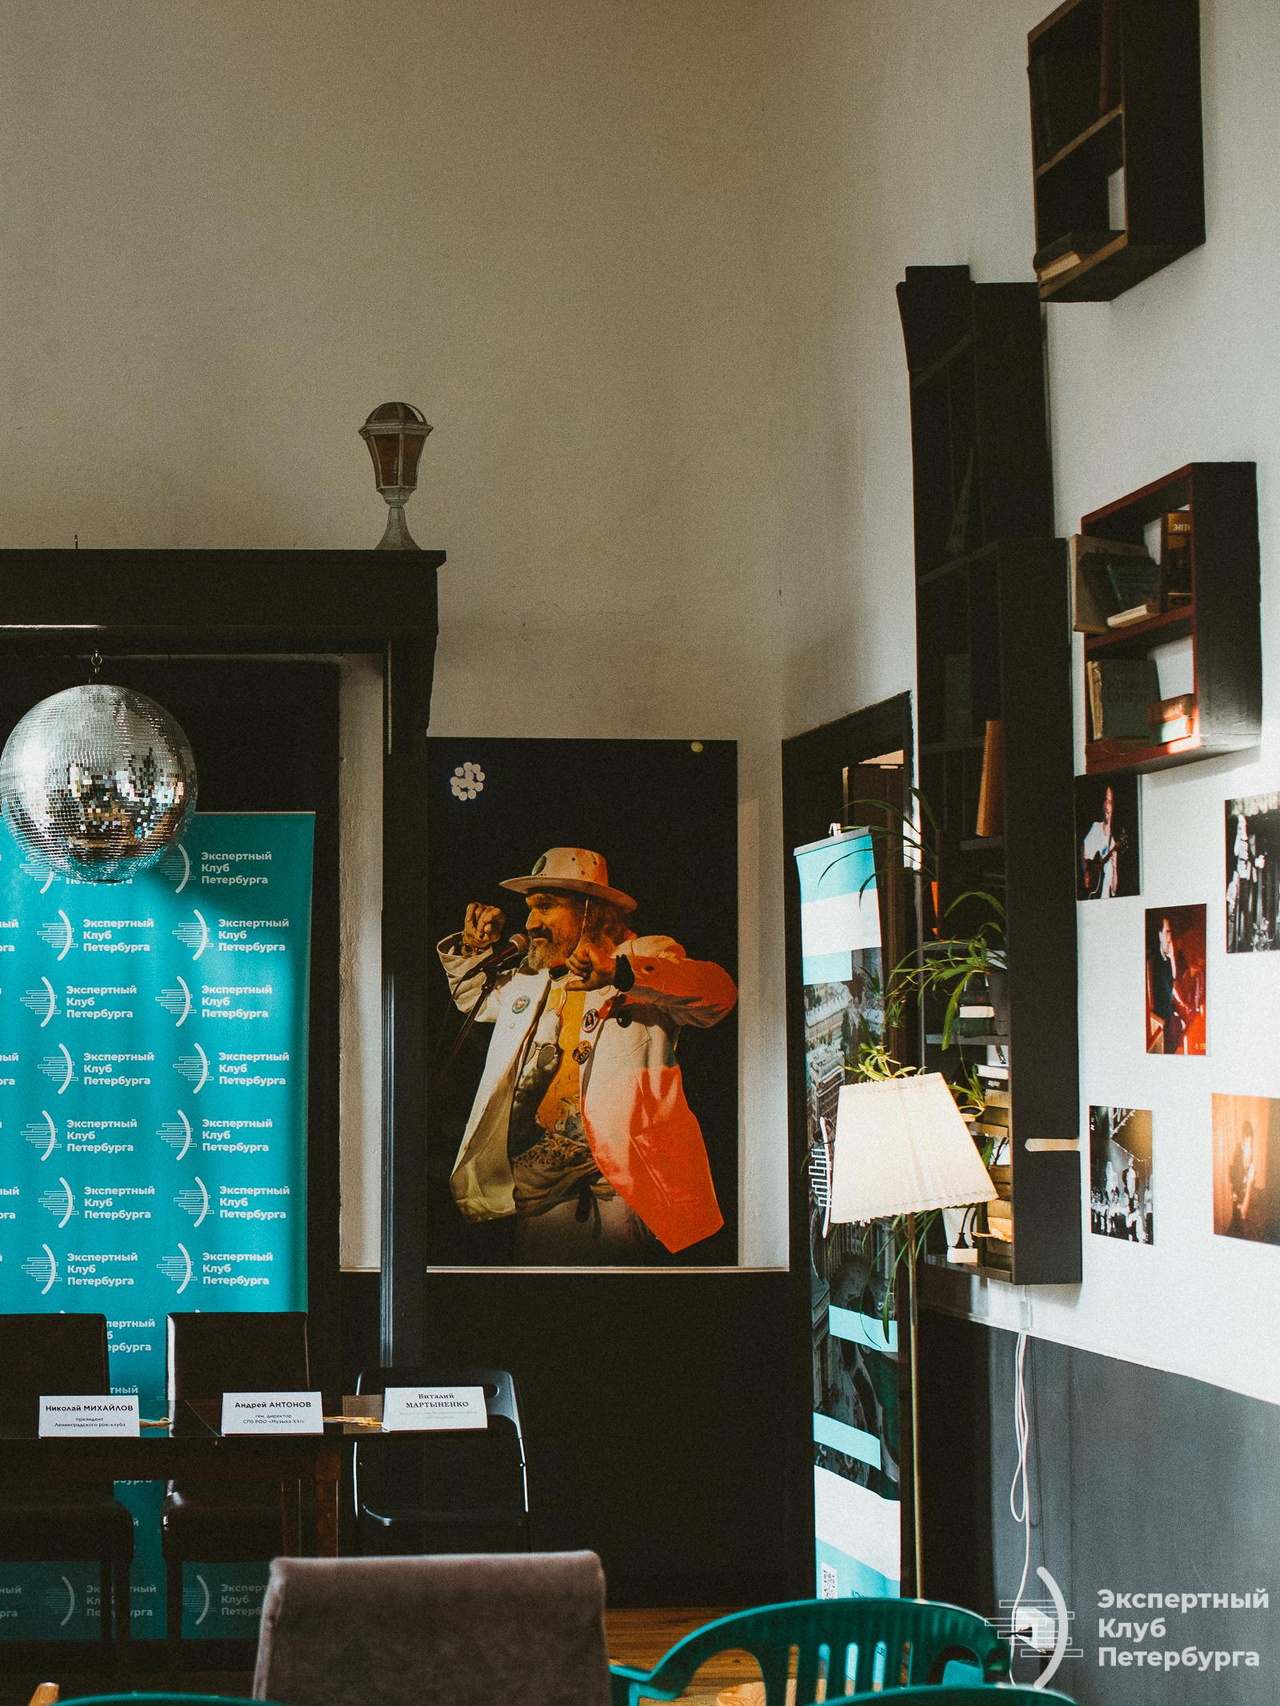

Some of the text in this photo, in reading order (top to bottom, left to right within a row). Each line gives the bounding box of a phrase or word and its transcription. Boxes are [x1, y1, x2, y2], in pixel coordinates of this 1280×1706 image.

[202, 851, 272, 864] Экспертный
[202, 863, 229, 875] Клуб
[202, 875, 268, 887] Петербурга
[83, 918, 154, 931] Экспертный
[219, 918, 289, 931] Экспертный
[83, 930, 112, 942] Клуб
[219, 930, 247, 942] Клуб
[84, 941, 150, 954] Петербурга
[218, 941, 285, 954] Петербурга
[67, 984, 136, 997] Экспертный
[202, 984, 272, 997] Экспертный
[67, 997, 94, 1009] Клуб
[202, 997, 230, 1009] Клуб
[67, 1008, 133, 1021] Петербурга
[202, 1008, 268, 1021] Петербурга
[84, 1051, 154, 1064] Экспертный
[219, 1051, 289, 1064] Экспертный
[84, 1063, 112, 1075] Клуб
[219, 1063, 247, 1075] Клуб
[84, 1075, 150, 1087] Петербурга
[219, 1075, 285, 1087] Петербурга
[67, 1118, 137, 1131] Экспертный
[203, 1118, 272, 1131] Экспертный
[67, 1130, 95, 1142] Клуб
[203, 1130, 230, 1142] Клуб
[67, 1142, 133, 1154] Петербурга
[203, 1142, 269, 1154] Петербурга
[85, 1185, 155, 1198] Экспертный
[220, 1185, 289, 1198] Экспертный
[85, 1197, 112, 1209] Клуб
[220, 1197, 248, 1209] Клуб
[85, 1208, 151, 1221] Петербурга
[220, 1208, 286, 1221] Петербурга
[68, 1251, 138, 1264] Экспертный
[203, 1251, 273, 1264] Экспертный
[68, 1263, 96, 1275] Клуб
[203, 1263, 231, 1275] Клуб
[68, 1275, 134, 1287] Петербурга
[203, 1275, 269, 1287] Петербурга
[106, 1319, 155, 1330] пертный
[107, 1342, 152, 1353] ербурга
[45, 1402, 134, 1412] Николай МИХАЙЛОВ
[234, 1400, 312, 1409] Андрей АНТОНОВ
[405, 1400, 469, 1409] МАРТЫНЕНКО
[221, 1583, 268, 1593] Эксперт
[221, 1595, 250, 1606] Клуб
[221, 1606, 262, 1617] Петерб
